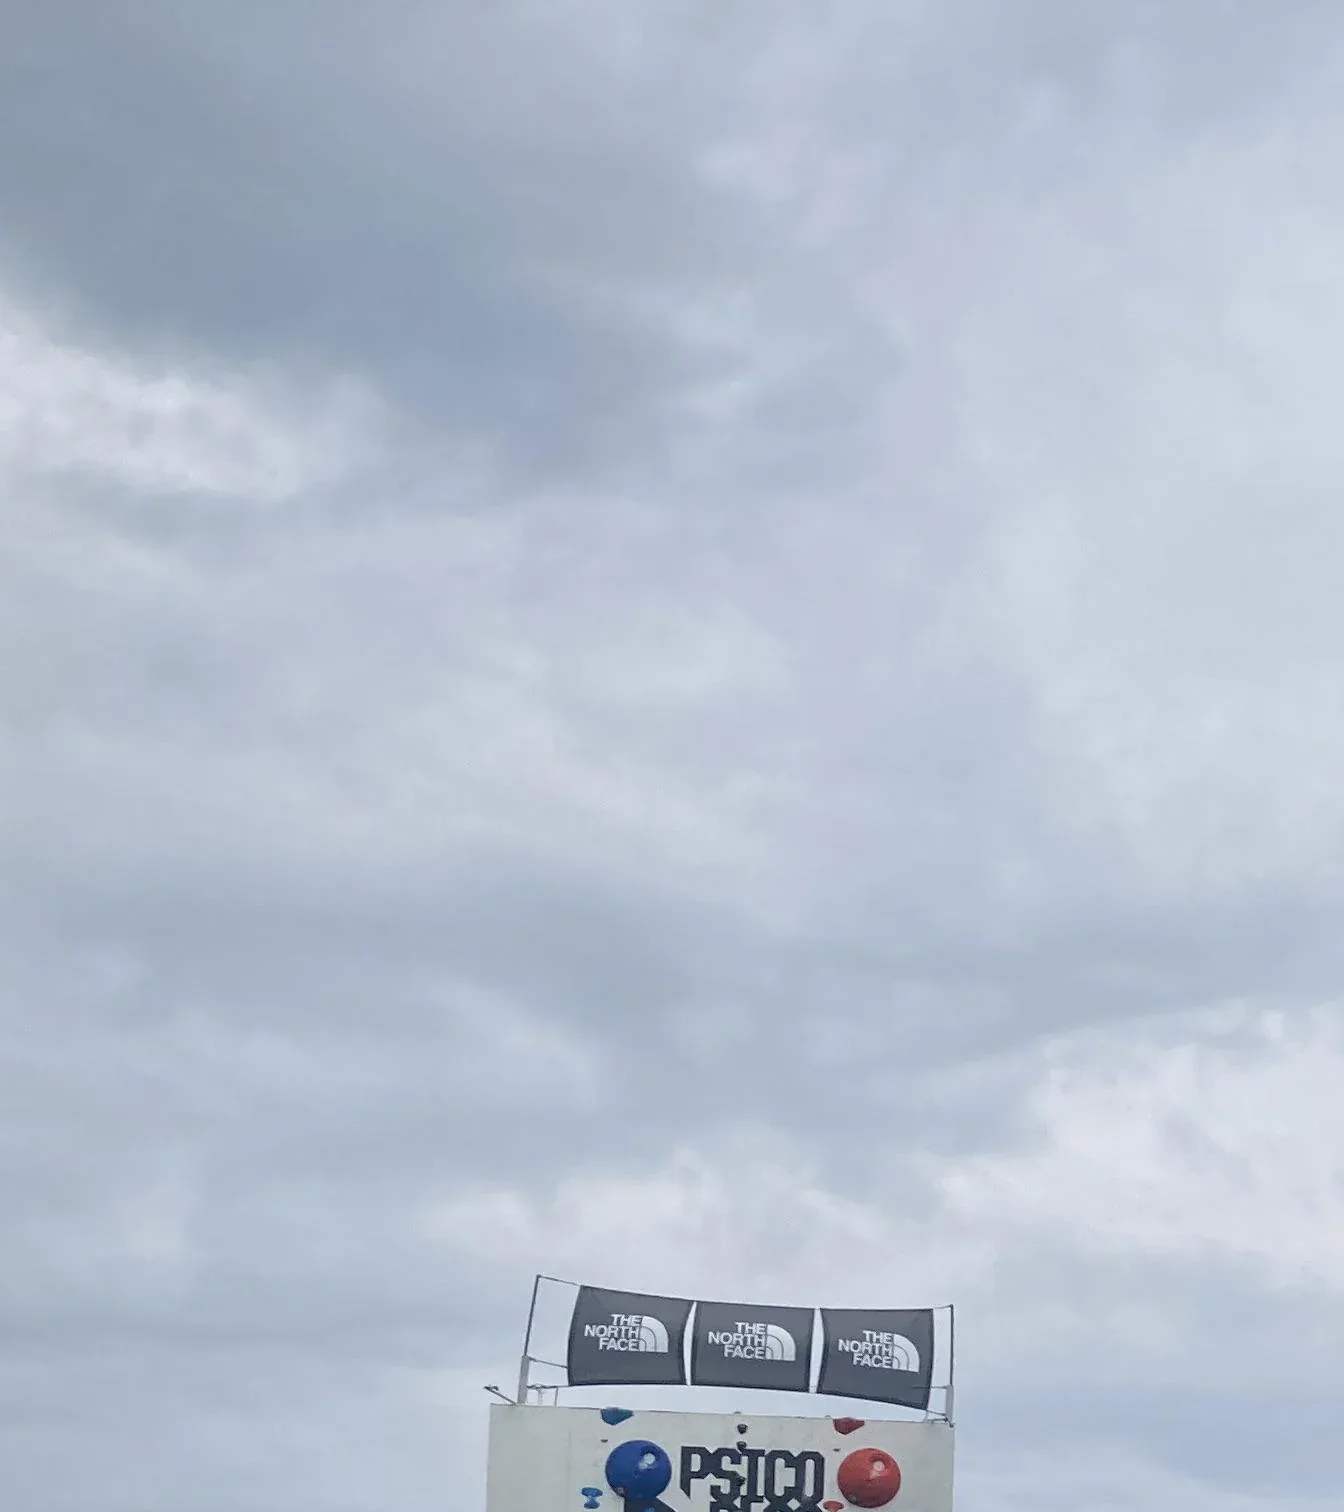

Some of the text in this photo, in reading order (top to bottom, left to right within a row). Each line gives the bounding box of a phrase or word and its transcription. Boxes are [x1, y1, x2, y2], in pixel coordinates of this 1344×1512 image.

[611, 1314, 642, 1326] THE
[584, 1324, 640, 1339] NORTH
[735, 1322, 766, 1335] THE
[708, 1332, 766, 1346] NORTH
[862, 1330, 893, 1343] THE
[599, 1337, 640, 1351] FACE
[838, 1339, 893, 1356] NORTH
[723, 1346, 766, 1359] FACE
[852, 1354, 893, 1369] FACE
[680, 1446, 825, 1500] PSICO
